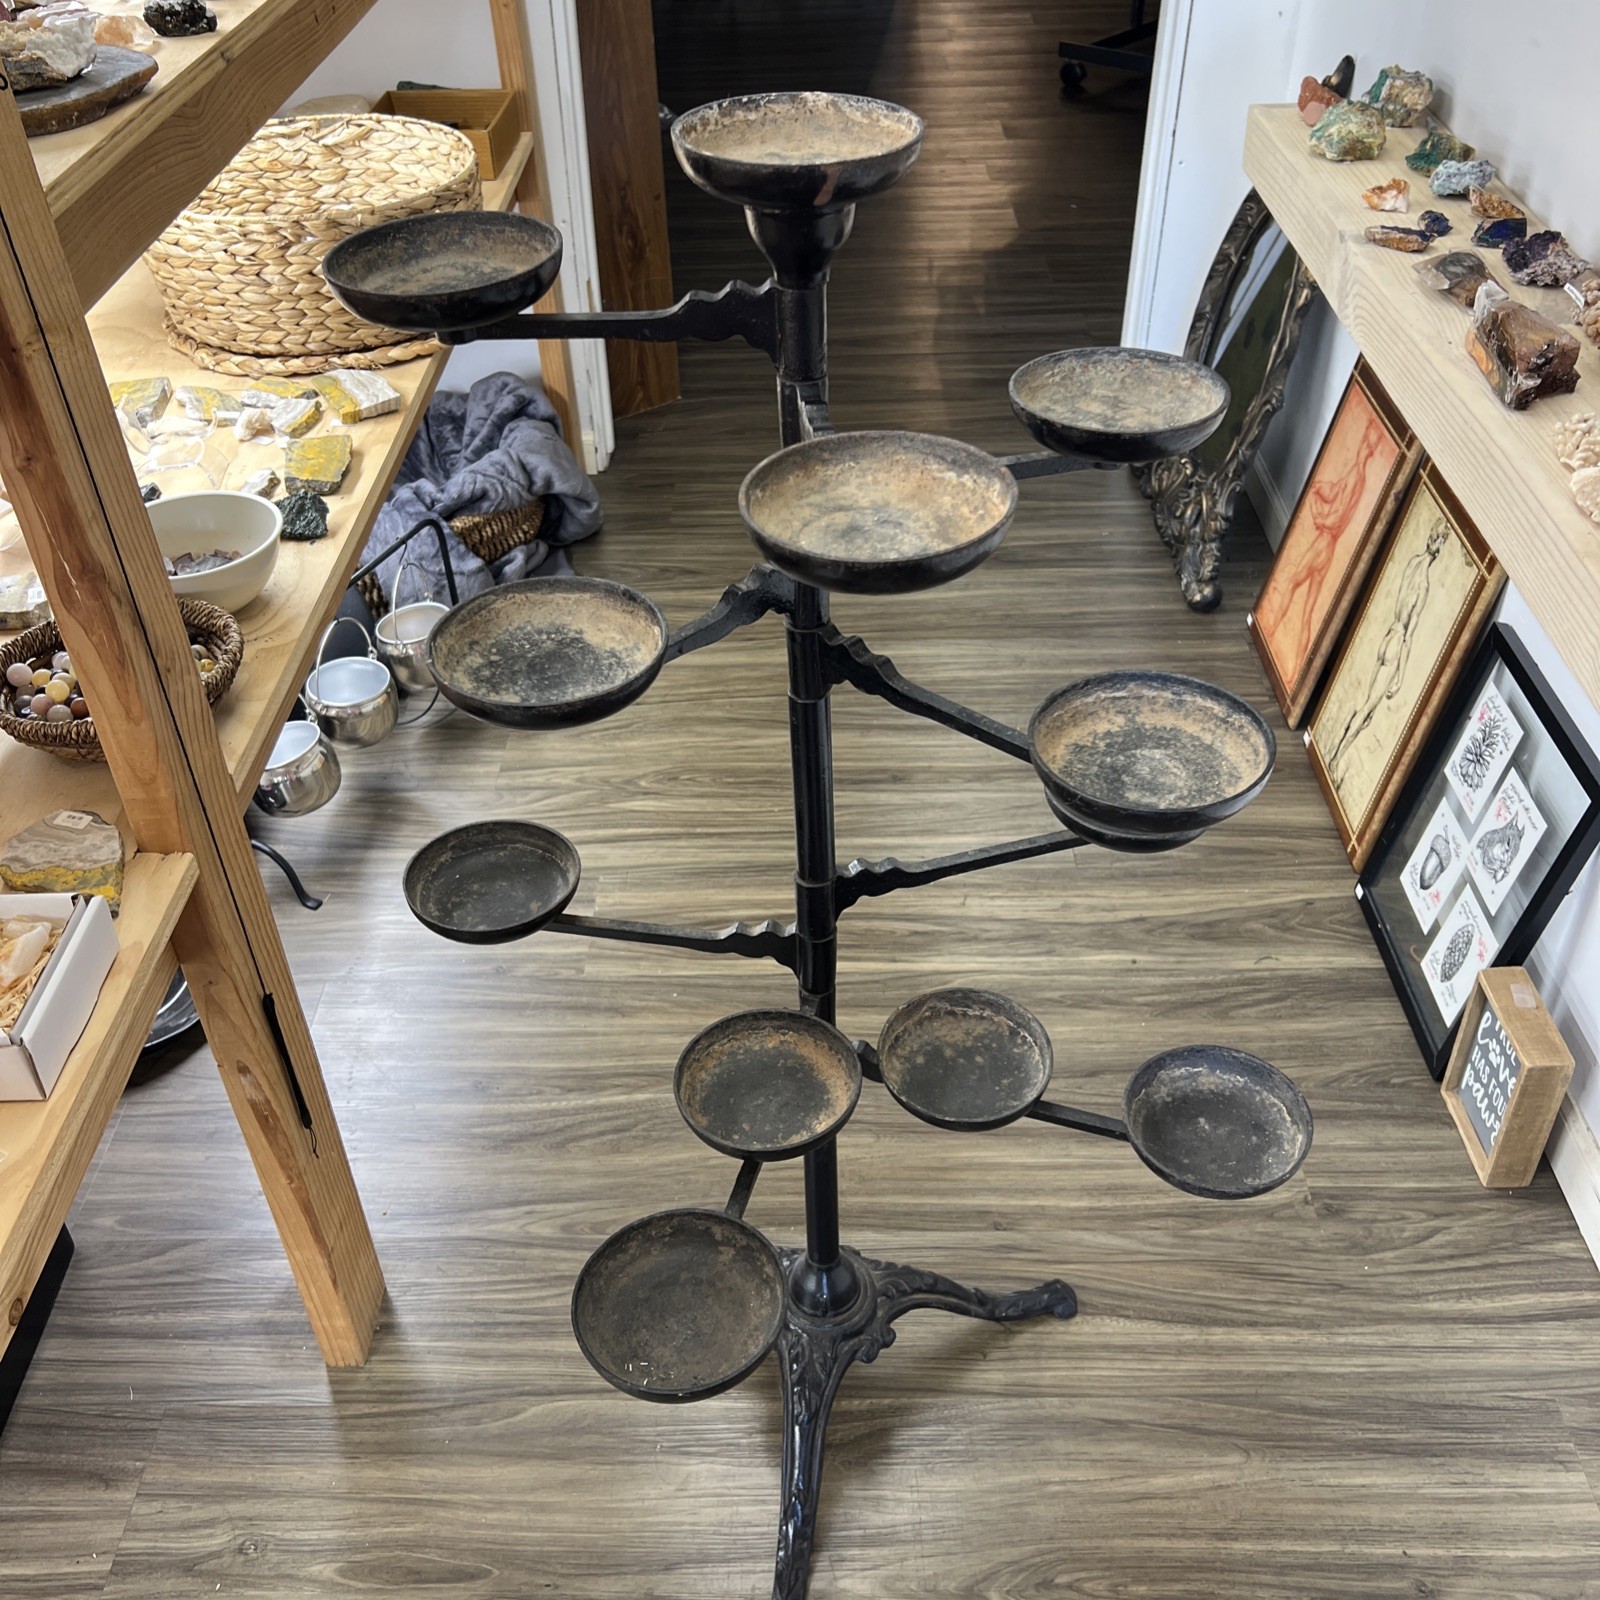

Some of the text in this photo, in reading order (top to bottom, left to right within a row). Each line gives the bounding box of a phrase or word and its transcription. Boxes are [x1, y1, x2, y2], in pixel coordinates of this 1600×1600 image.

[1461, 1063, 1501, 1147] paws
[1471, 1045, 1508, 1118] HAS FOU
